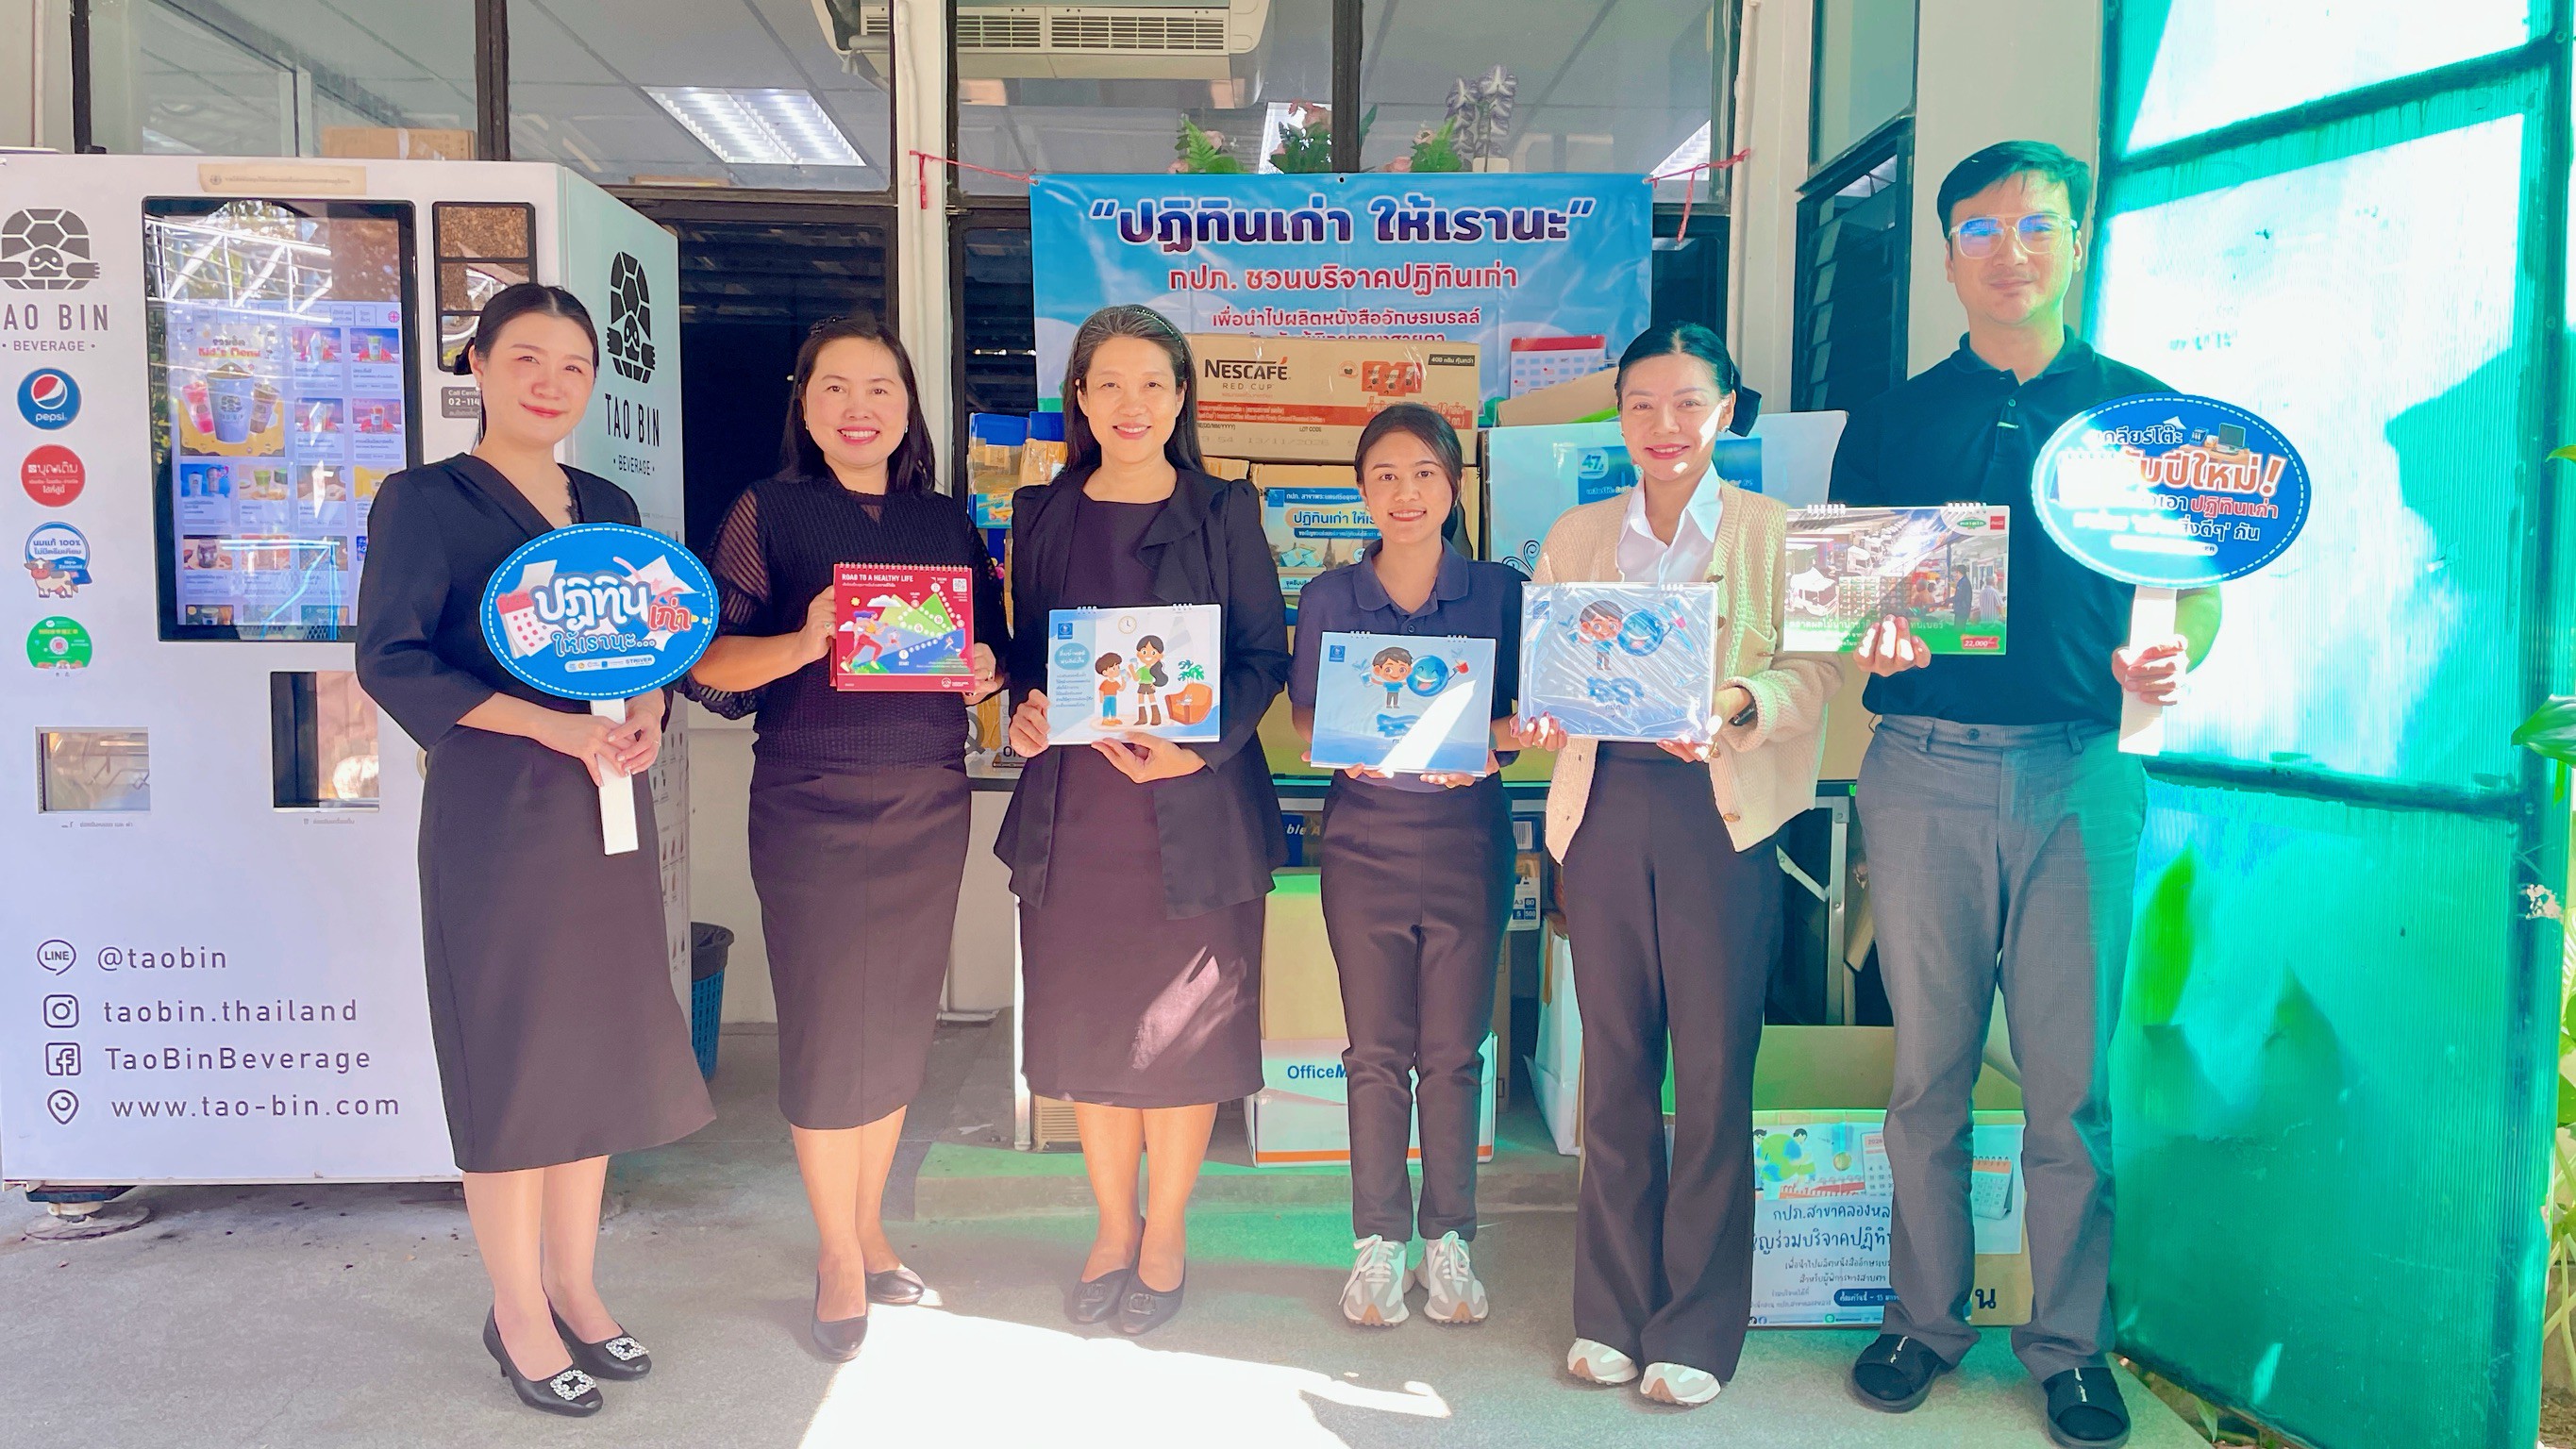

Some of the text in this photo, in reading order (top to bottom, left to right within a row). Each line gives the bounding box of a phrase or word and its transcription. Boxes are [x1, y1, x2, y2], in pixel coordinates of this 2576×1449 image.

[1170, 261, 1517, 295] กปภ. ชวนบริจาคปฏิทินเก่า
[4, 304, 109, 331] AO BIN
[1213, 307, 1480, 326] เพื่อนำไปผลิตหนังสืออักษรเบรลล์
[13, 341, 85, 351] BEVERAGE
[1205, 357, 1288, 380] NESCAFÉ
[1222, 382, 1245, 391] RED
[448, 397, 480, 406] 02-114
[35, 412, 65, 423] pepsi
[605, 392, 660, 447] TAO BIN
[2098, 425, 2183, 443] คลียร์โต๊ะ
[618, 454, 651, 475] BEVERAGE
[2125, 449, 2285, 495] ับปีใหม่!
[1294, 510, 1348, 525] ปฏิทินเก่า
[2192, 497, 2278, 518] ปฏิทินเก่า
[33, 538, 57, 546] นมแท้
[2234, 524, 2260, 541] กัน
[535, 575, 648, 629] ปฏิทิน
[649, 597, 692, 631] เก่า
[1286, 824, 1308, 835] ble
[44, 946, 226, 971] LINE @taobin
[104, 1000, 357, 1023] taobin.thailand
[105, 1048, 370, 1074] TaoBinBeverage
[1287, 1064, 1347, 1079] OfficeM
[111, 1095, 399, 1117] www.tao-bin.com
[1773, 1205, 1890, 1222] กปภ.สาขาคลองหล
[1753, 1227, 1891, 1255] ญร่วมบริจาคปฏิทิ
[1785, 1256, 1890, 1270] เพื่อนำไปผลิตหนังสืออักษรเบร
